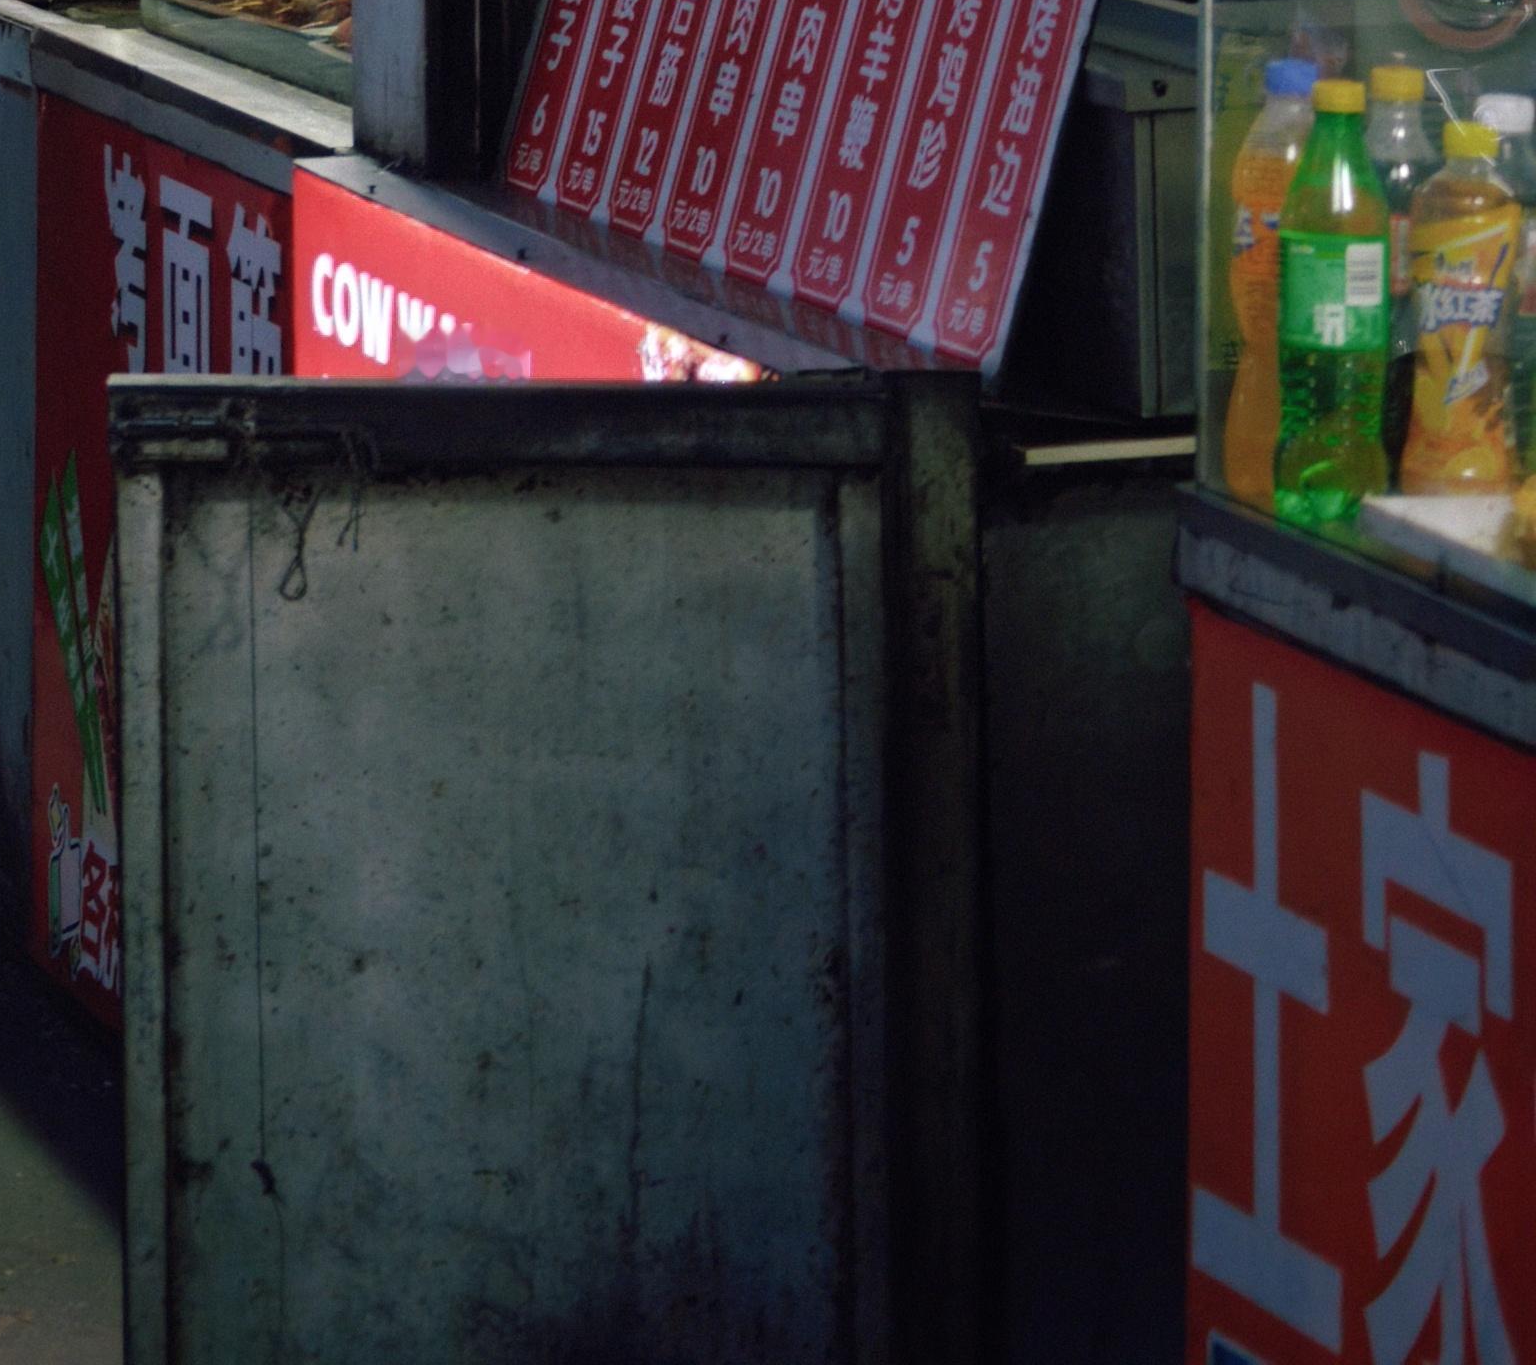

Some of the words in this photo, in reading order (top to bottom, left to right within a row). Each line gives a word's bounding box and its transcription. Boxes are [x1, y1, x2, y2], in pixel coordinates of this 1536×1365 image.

[531, 94, 549, 137] 6
[582, 109, 607, 156] 15
[634, 127, 659, 177] 12
[691, 145, 717, 196] 10
[753, 167, 782, 220] 10
[823, 189, 853, 244] 10
[895, 216, 921, 267] 5
[968, 241, 994, 293] 5
[312, 252, 394, 366] COW
[1190, 681, 1516, 1365] 土家
